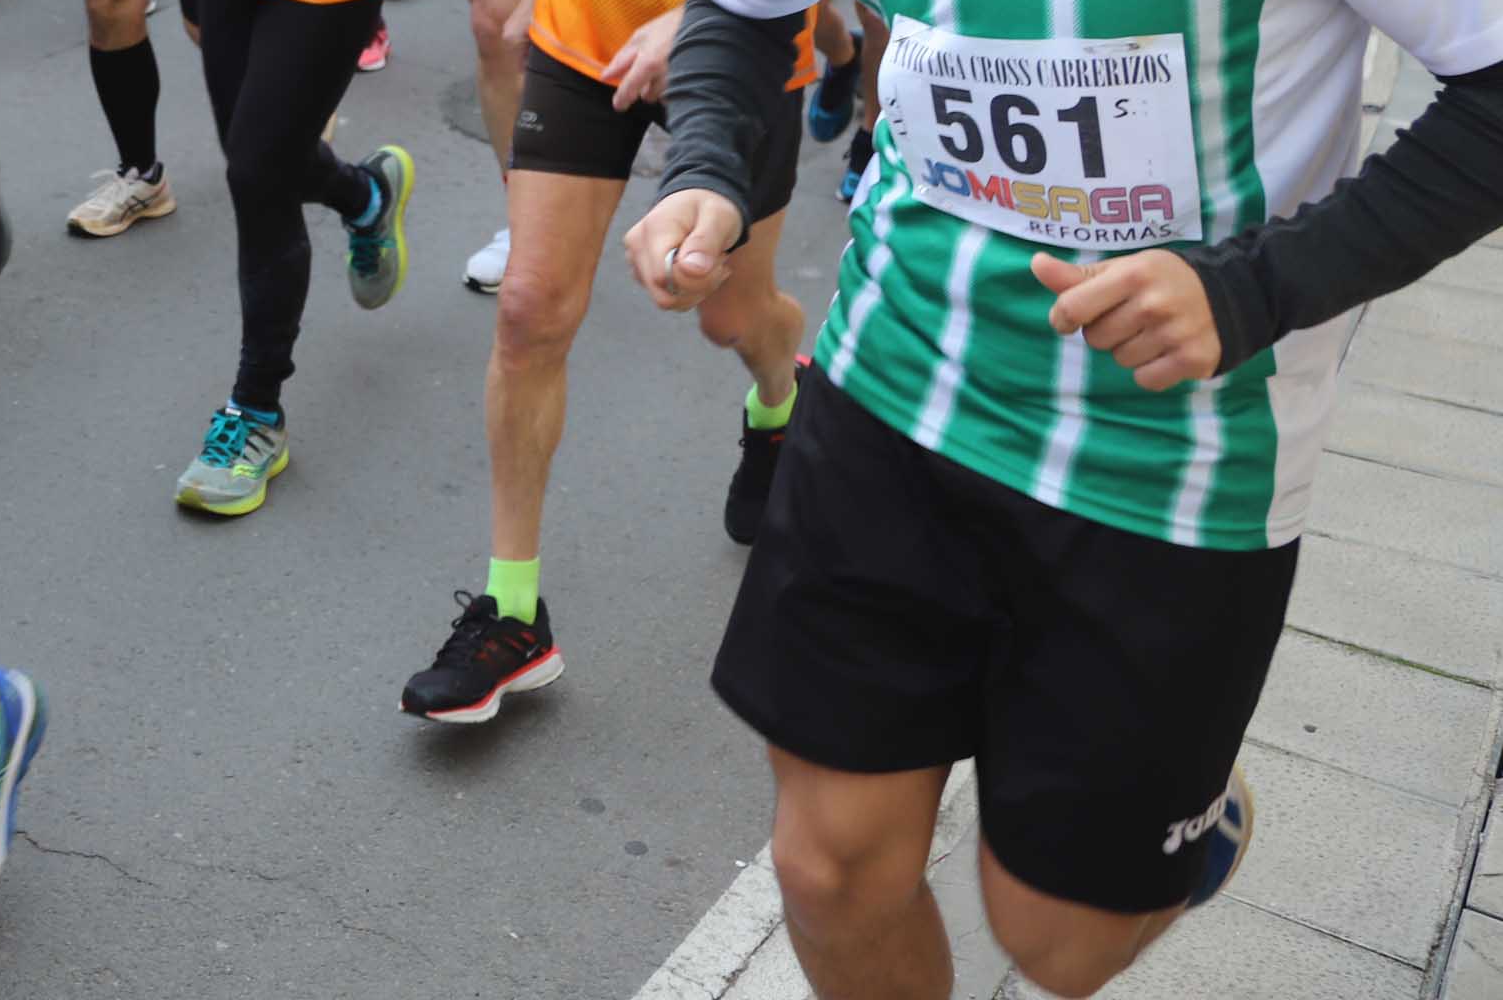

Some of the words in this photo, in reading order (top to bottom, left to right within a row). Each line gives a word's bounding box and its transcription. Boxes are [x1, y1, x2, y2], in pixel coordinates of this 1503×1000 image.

[970, 55, 1033, 88] CROSS
[1036, 53, 1173, 88] CABRERIZOS
[930, 83, 1107, 179] 561
[922, 157, 1175, 225] JOMISAGA
[1027, 219, 1173, 243] REFORMAS
